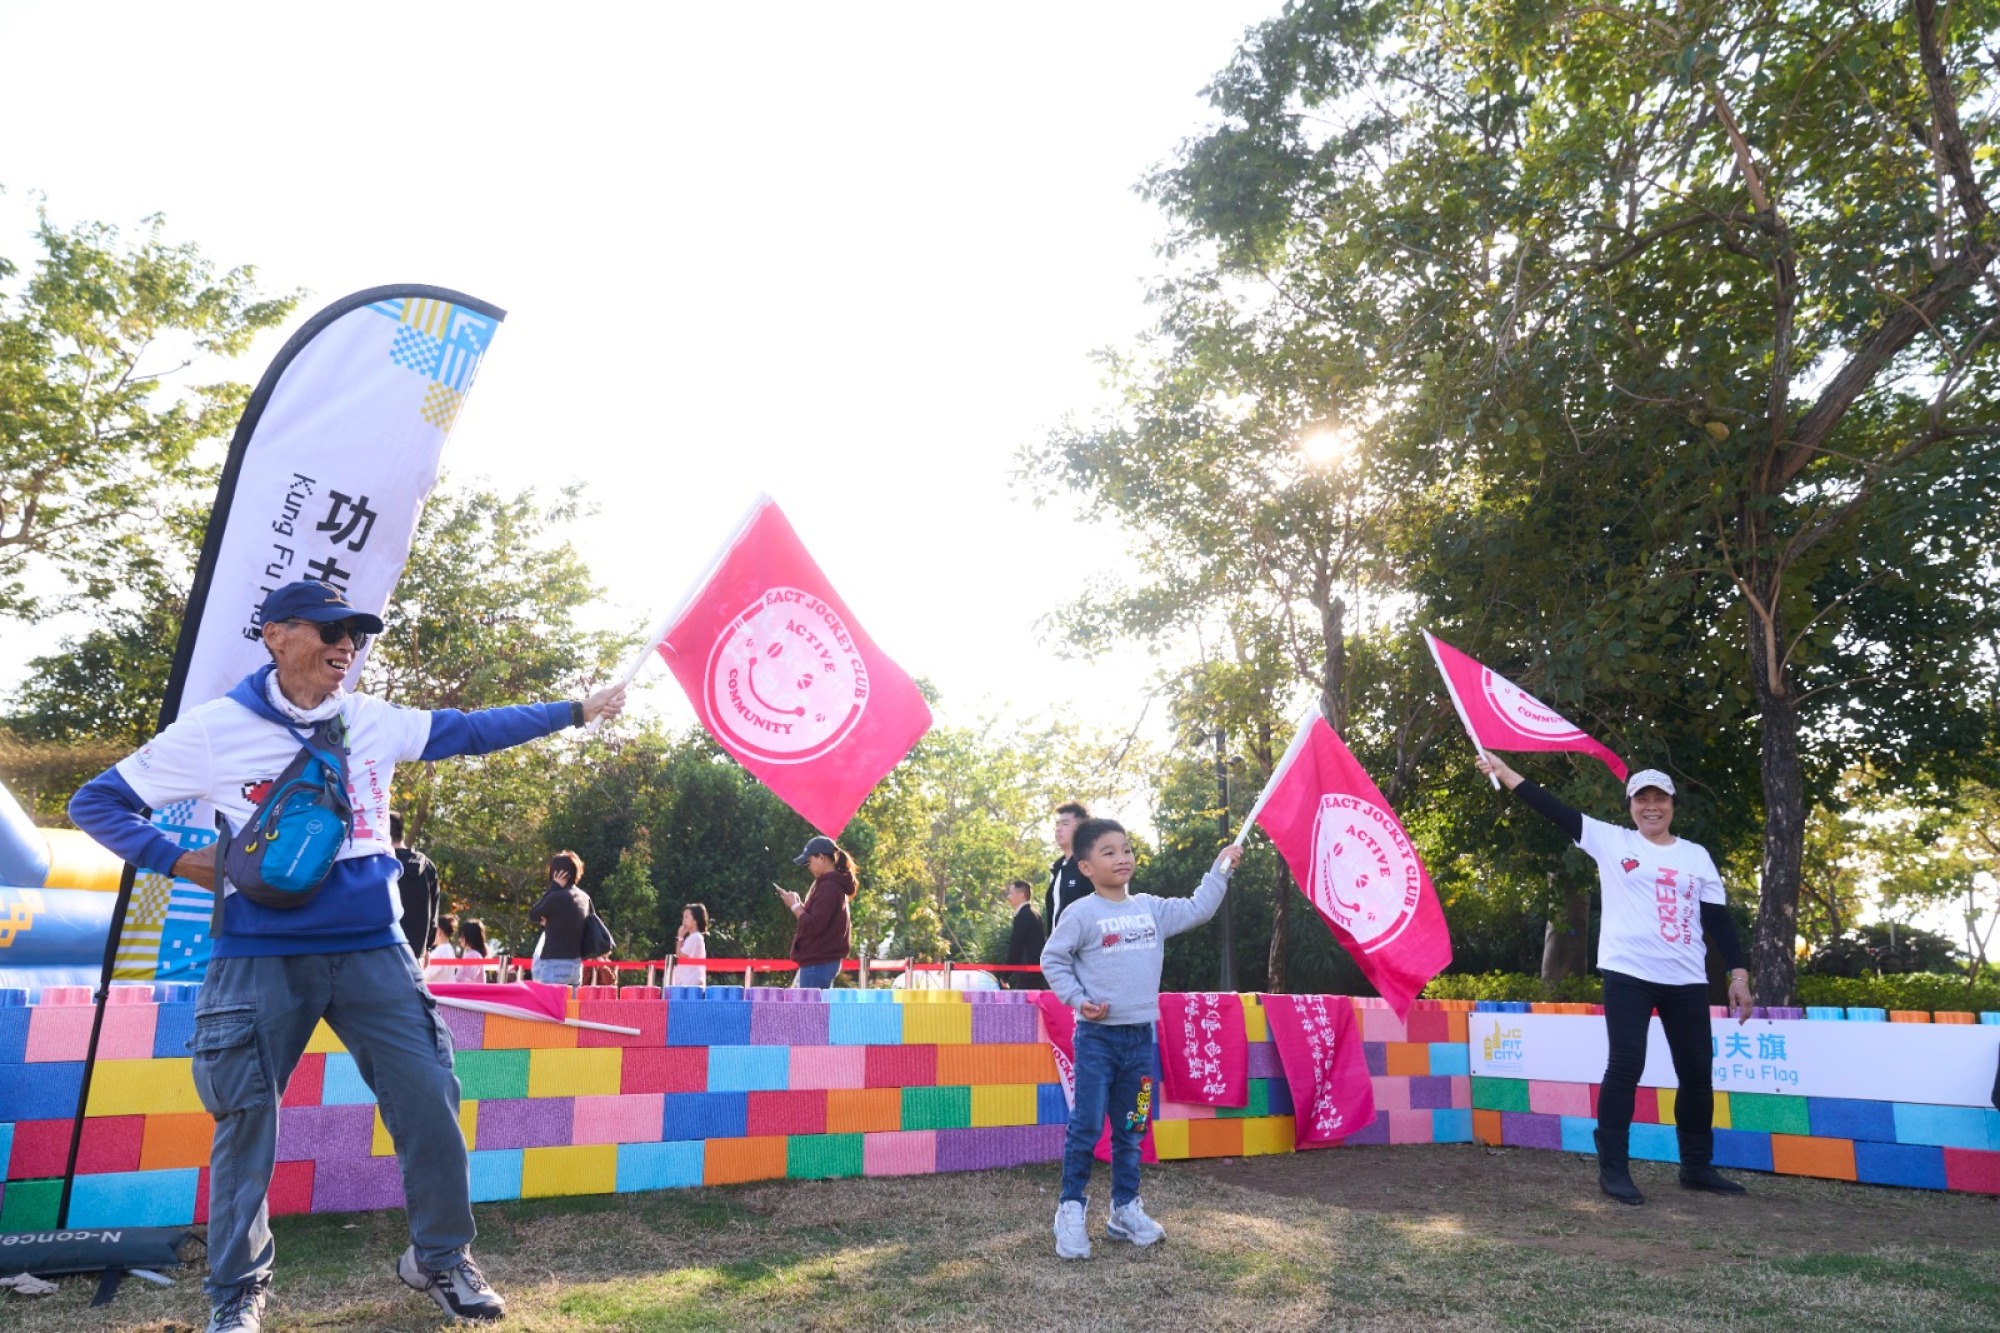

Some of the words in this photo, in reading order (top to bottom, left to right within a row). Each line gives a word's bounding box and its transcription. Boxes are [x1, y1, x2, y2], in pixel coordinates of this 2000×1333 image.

[273, 472, 316, 537] Kung
[264, 544, 294, 579] Fu
[785, 619, 836, 673] ACTIVE
[805, 597, 857, 660] JOCKEY
[850, 657, 867, 699] CLUB
[727, 668, 793, 735] COMMUNITY
[1346, 824, 1391, 878] ACTIVE
[1363, 805, 1413, 860] JOCKEY
[1404, 864, 1418, 907] CLUB
[1656, 867, 1681, 943] CREW
[1502, 1028, 1521, 1038] JC
[1502, 1040, 1522, 1050] FIT
[1712, 1032, 1788, 1061] 夫旗
[1494, 1050, 1523, 1061] CITY
[1733, 1064, 1755, 1079] Fu
[1761, 1064, 1799, 1085] Flag
[0, 1231, 122, 1246] N-conce
